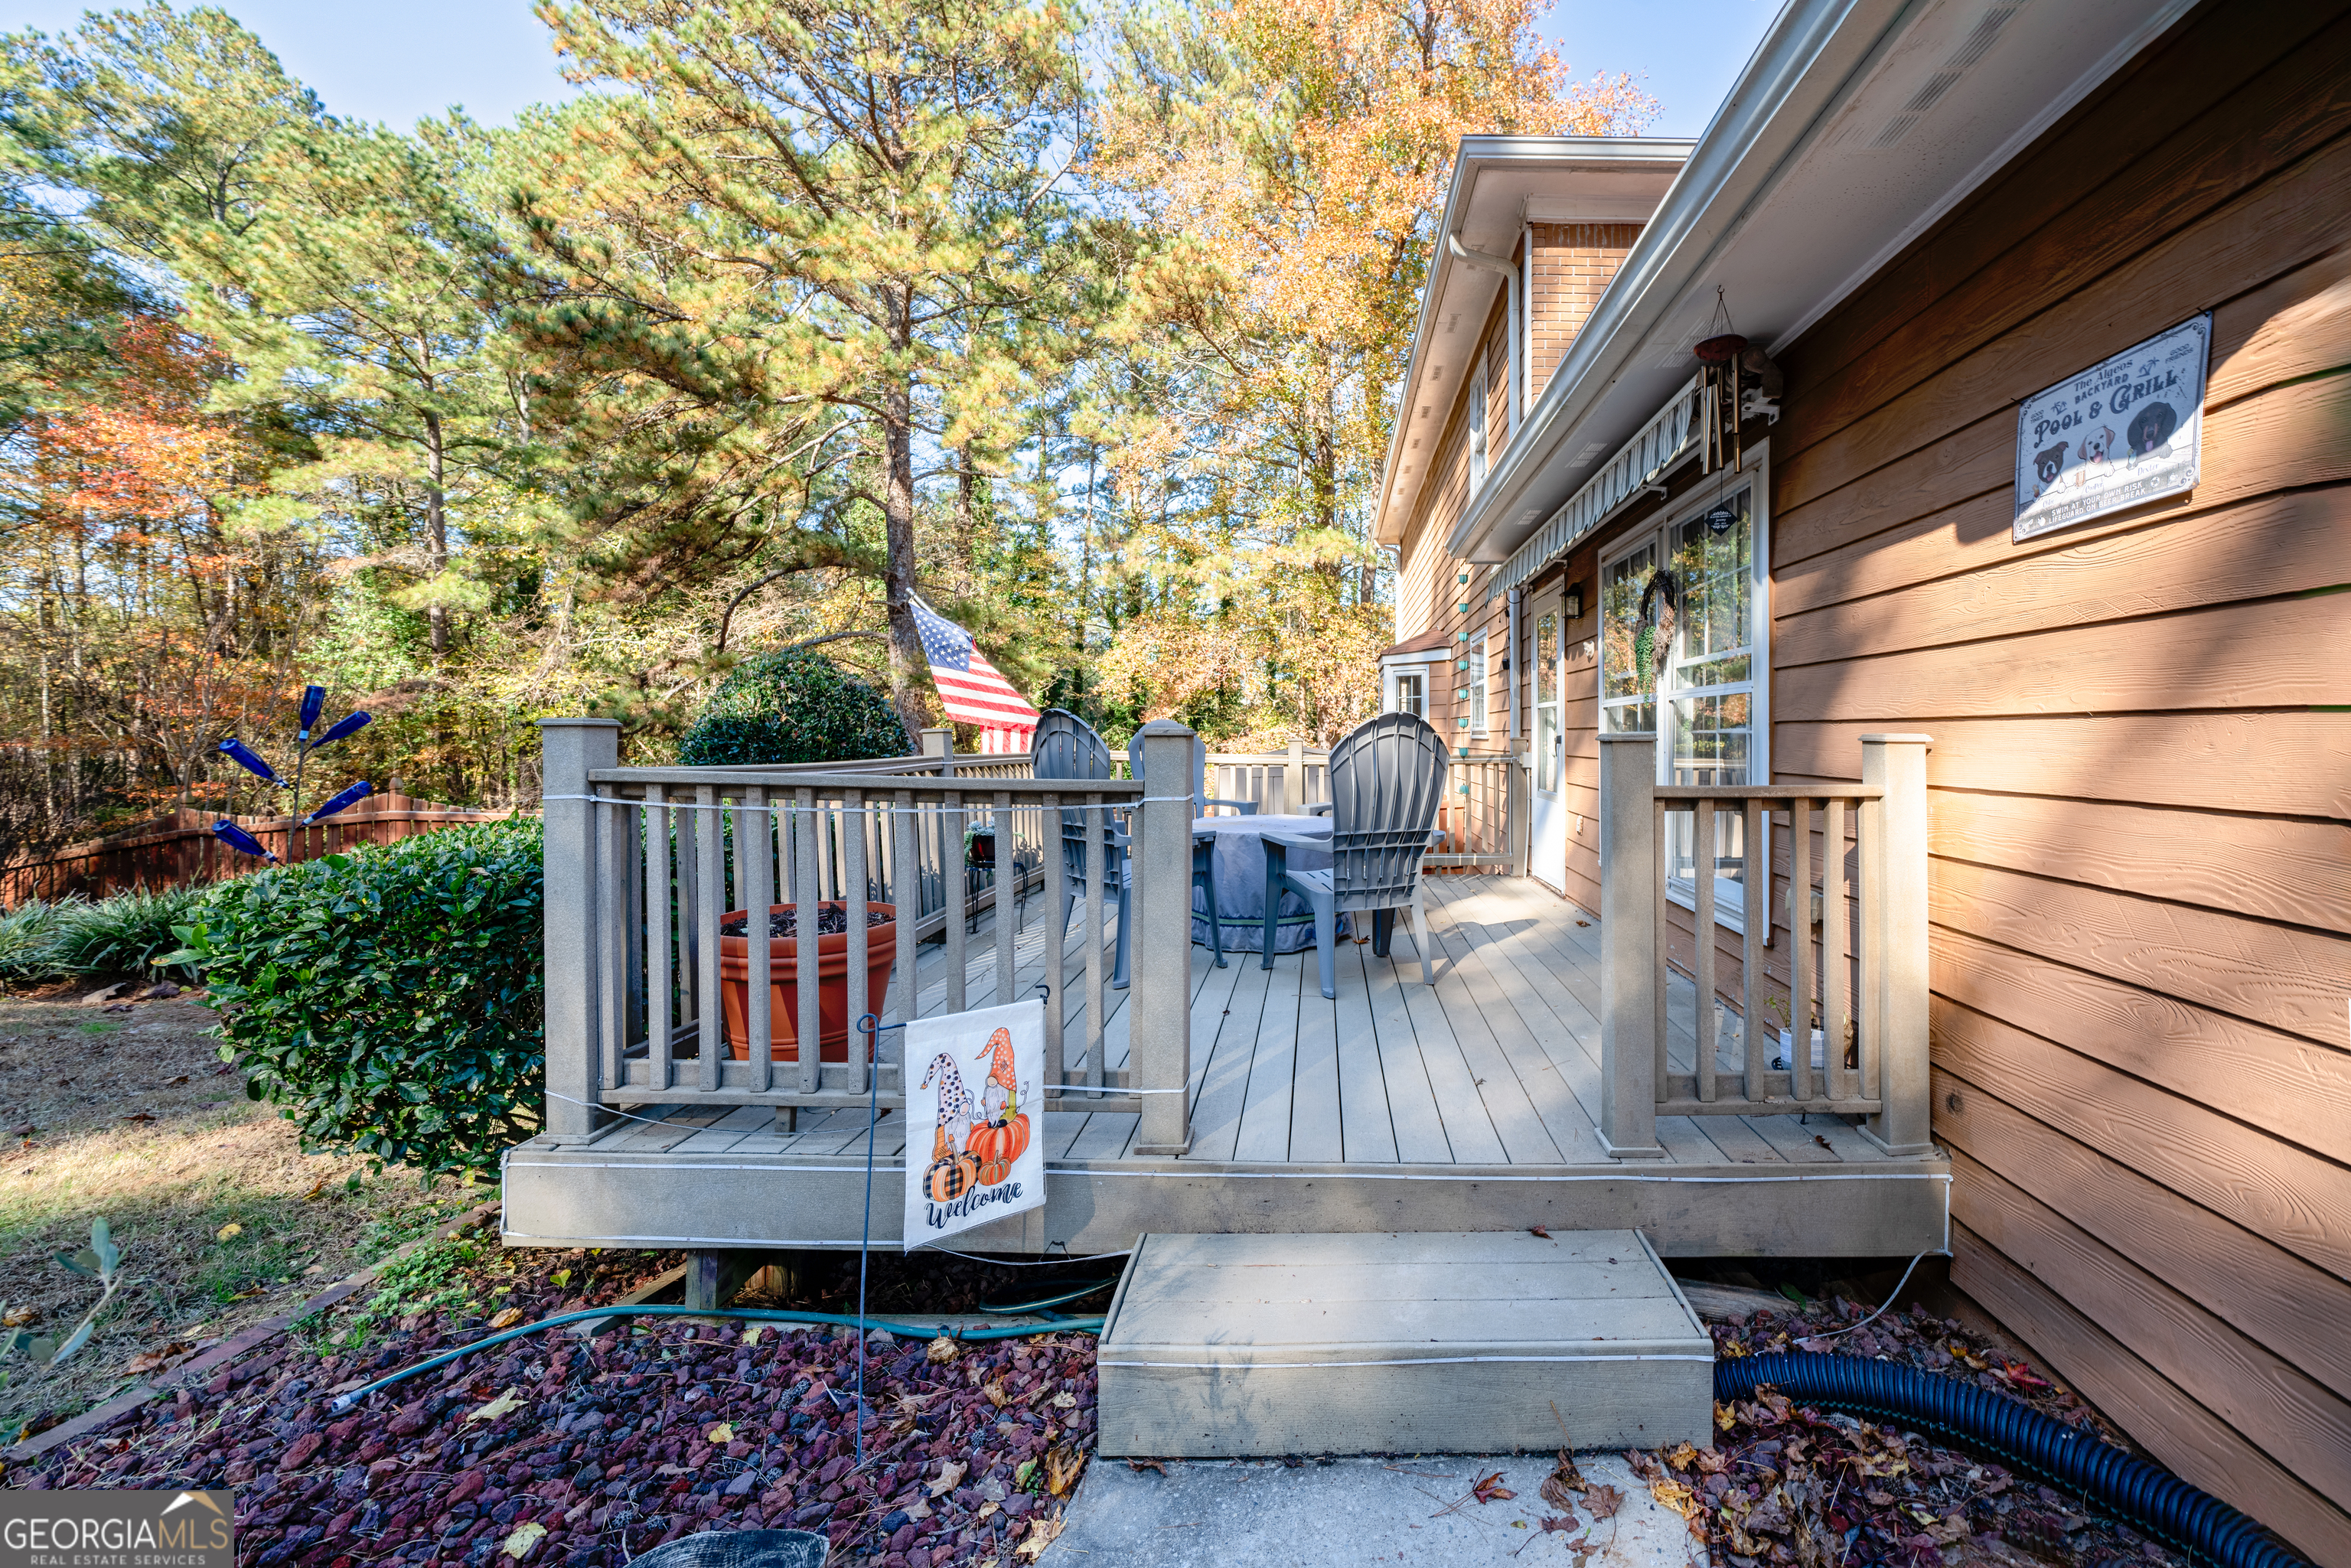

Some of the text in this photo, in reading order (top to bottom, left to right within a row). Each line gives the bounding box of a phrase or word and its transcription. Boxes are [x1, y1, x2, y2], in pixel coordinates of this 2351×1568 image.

[2074, 359, 2134, 392] The Algeos
[2075, 373, 2129, 405] BACKYARD
[2033, 369, 2178, 448] POOL & GRILL
[2049, 488, 2146, 524] LIFEGUARD ON BEER BREAK
[2051, 481, 2143, 517] SWIM AT YOUR OWN RISK
